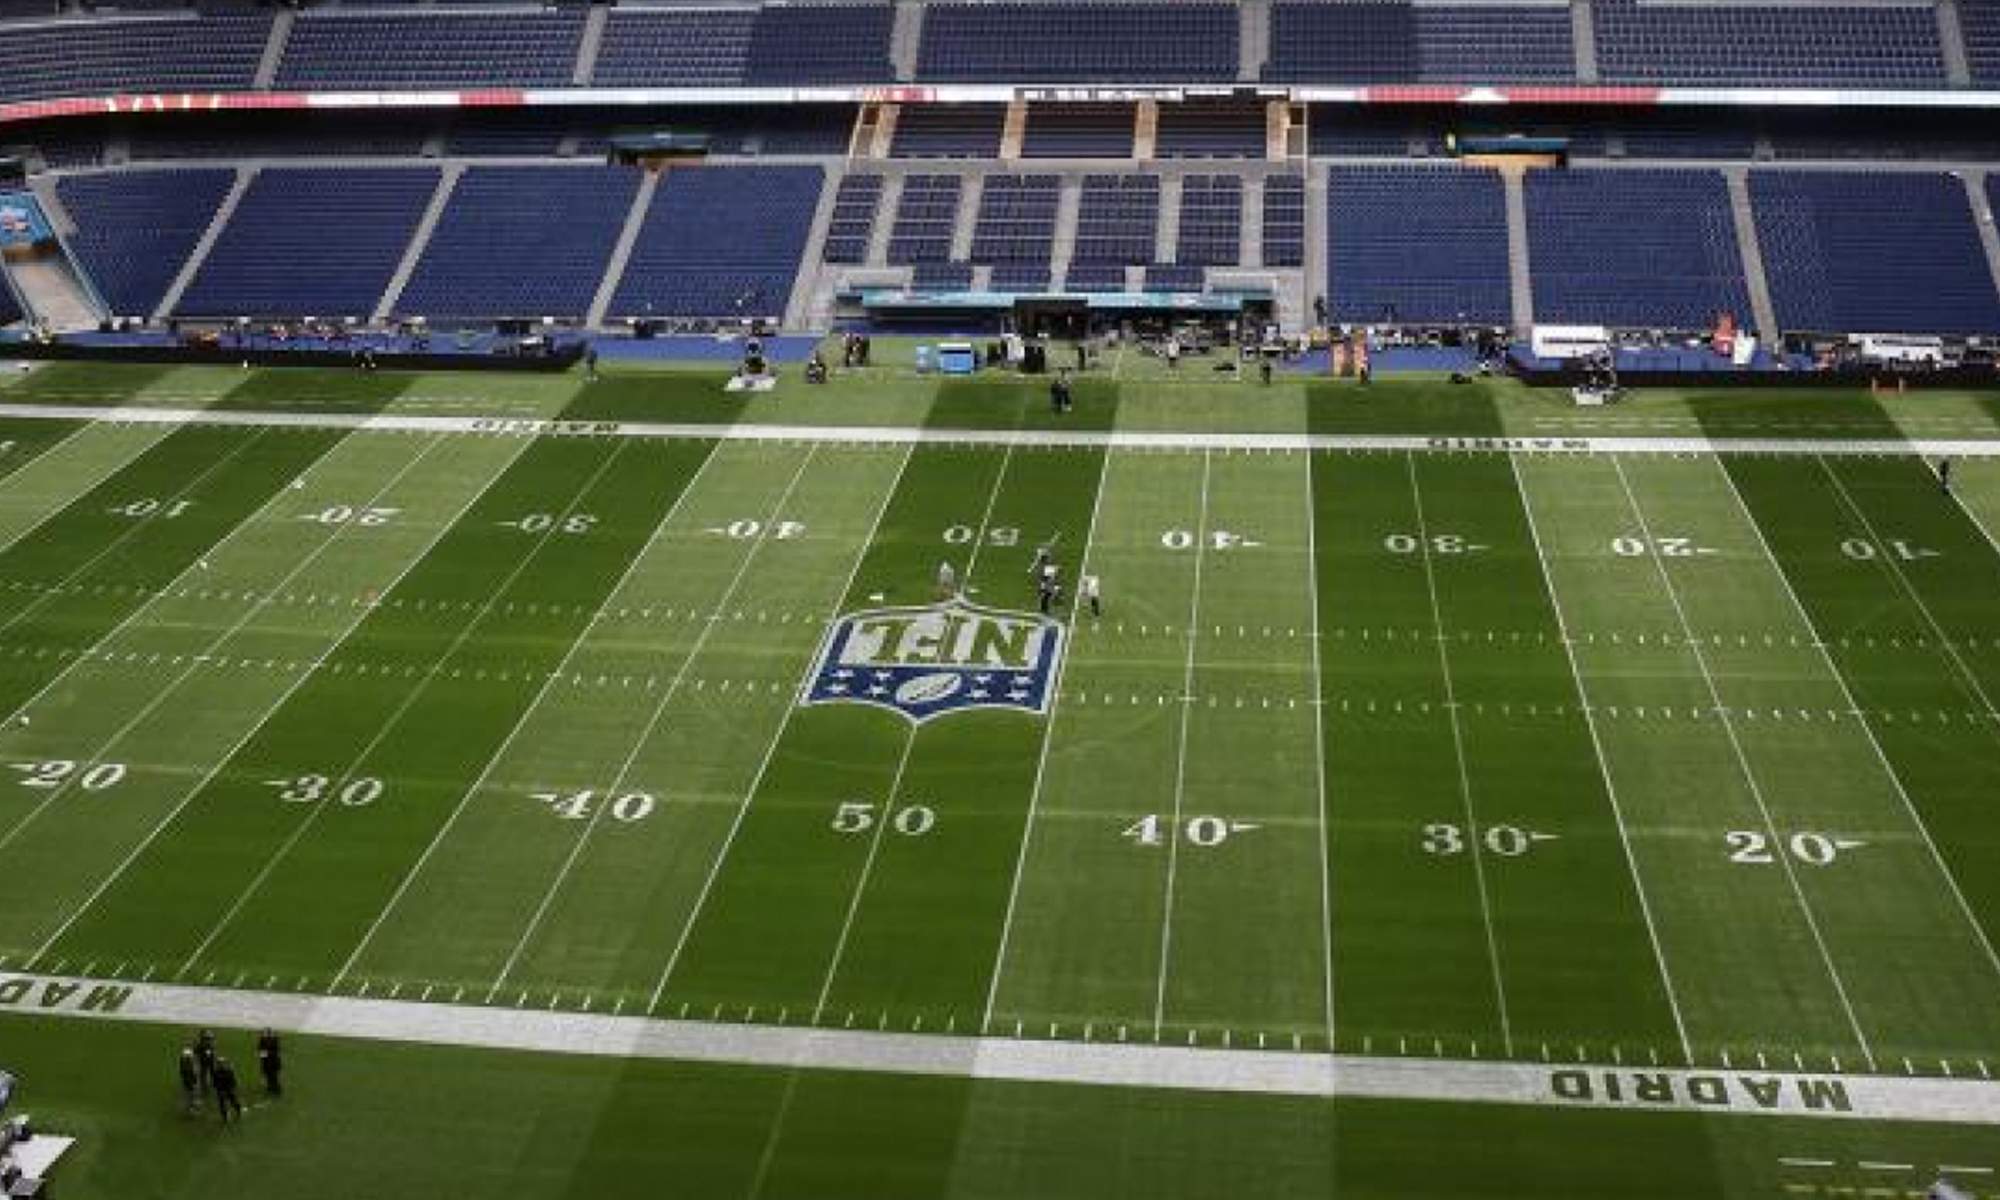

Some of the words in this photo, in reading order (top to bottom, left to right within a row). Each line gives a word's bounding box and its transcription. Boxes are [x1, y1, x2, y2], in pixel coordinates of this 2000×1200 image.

[317, 507, 400, 525] 20
[518, 513, 596, 532] 30
[727, 520, 804, 538] 40
[942, 525, 1020, 544] 50
[1161, 530, 1240, 549] 40
[1385, 534, 1465, 553] 30
[1611, 537, 1692, 556] 20
[1841, 540, 1916, 560] 10
[862, 612, 1037, 666] NFL
[20, 760, 125, 789] 20
[280, 775, 382, 804] 30
[553, 788, 655, 822] 40
[831, 803, 935, 835] 50
[1121, 814, 1227, 846] 40
[1422, 824, 1528, 856] 30
[1725, 830, 1836, 863] 20
[1551, 1070, 1852, 1111] MADRID
